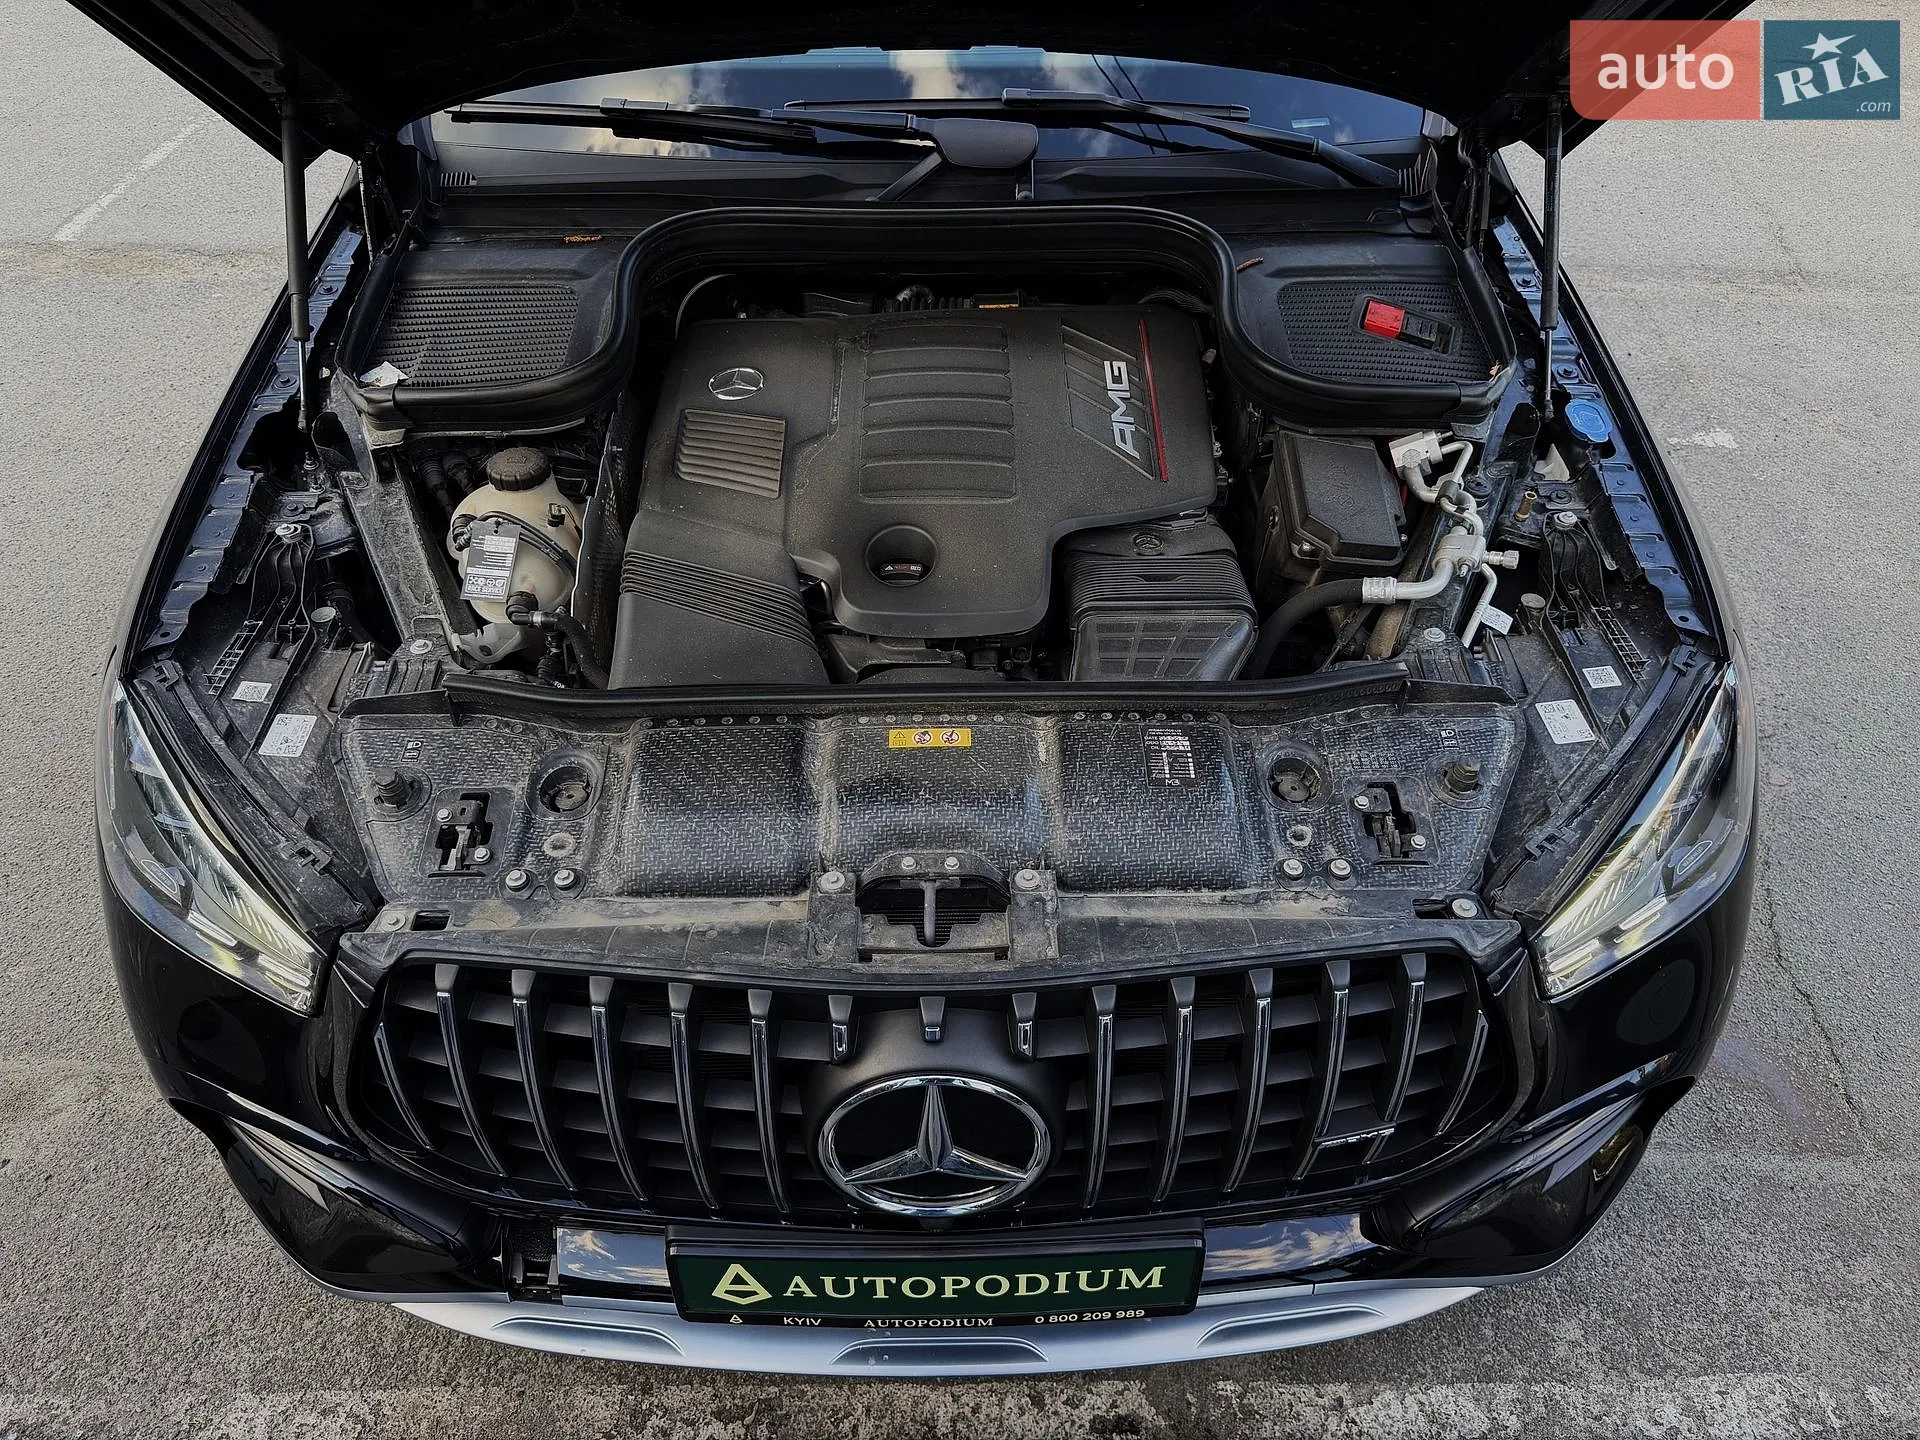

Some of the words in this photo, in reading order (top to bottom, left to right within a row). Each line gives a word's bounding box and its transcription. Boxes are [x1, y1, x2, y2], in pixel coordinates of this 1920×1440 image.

[1103, 360, 1141, 460] AMG
[783, 1265, 1167, 1299] AUTOPODIUM
[783, 1316, 821, 1326] KYIV
[864, 1317, 994, 1328] AUTOPODIUM
[1035, 1316, 1045, 1324] 0
[1049, 1314, 1078, 1323] 800
[1083, 1311, 1112, 1321] 209
[1116, 1309, 1145, 1319] 989
